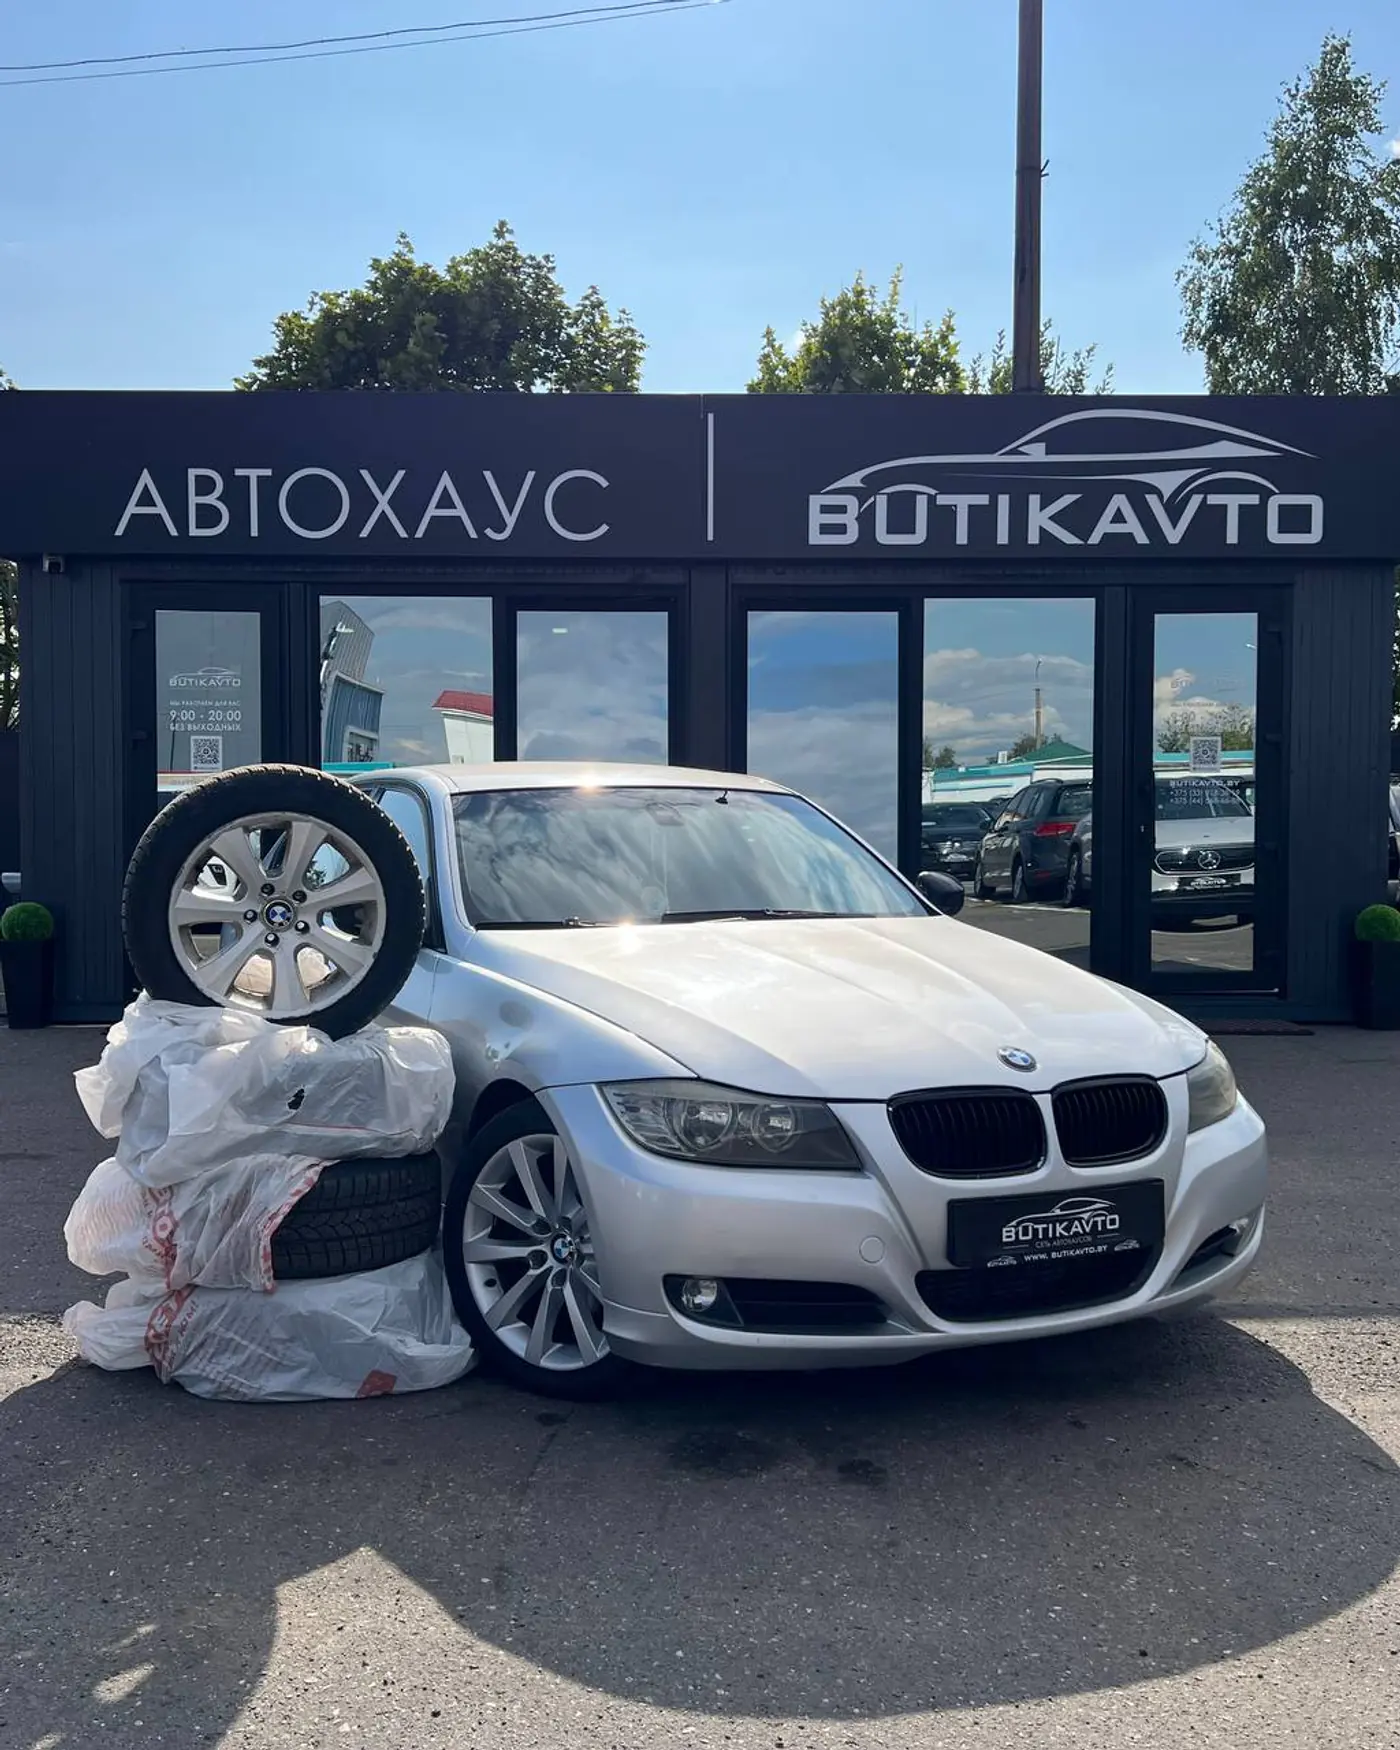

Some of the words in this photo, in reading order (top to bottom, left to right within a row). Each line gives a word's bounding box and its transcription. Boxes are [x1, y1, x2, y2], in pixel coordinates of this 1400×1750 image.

[114, 467, 610, 542] АВТОХАУС
[808, 493, 1324, 545] BUTIKAVTO
[169, 678, 241, 687] BUTIKAVTO
[169, 709, 195, 721] 9:00
[208, 709, 242, 721] 20:00
[187, 723, 241, 732] ВЫХОДНЫХ
[1002, 1214, 1120, 1242] BUTIKAVTO
[1024, 1253, 1049, 1262] WWW.
[1051, 1245, 1108, 1259] BUTIKAVTO.BY
